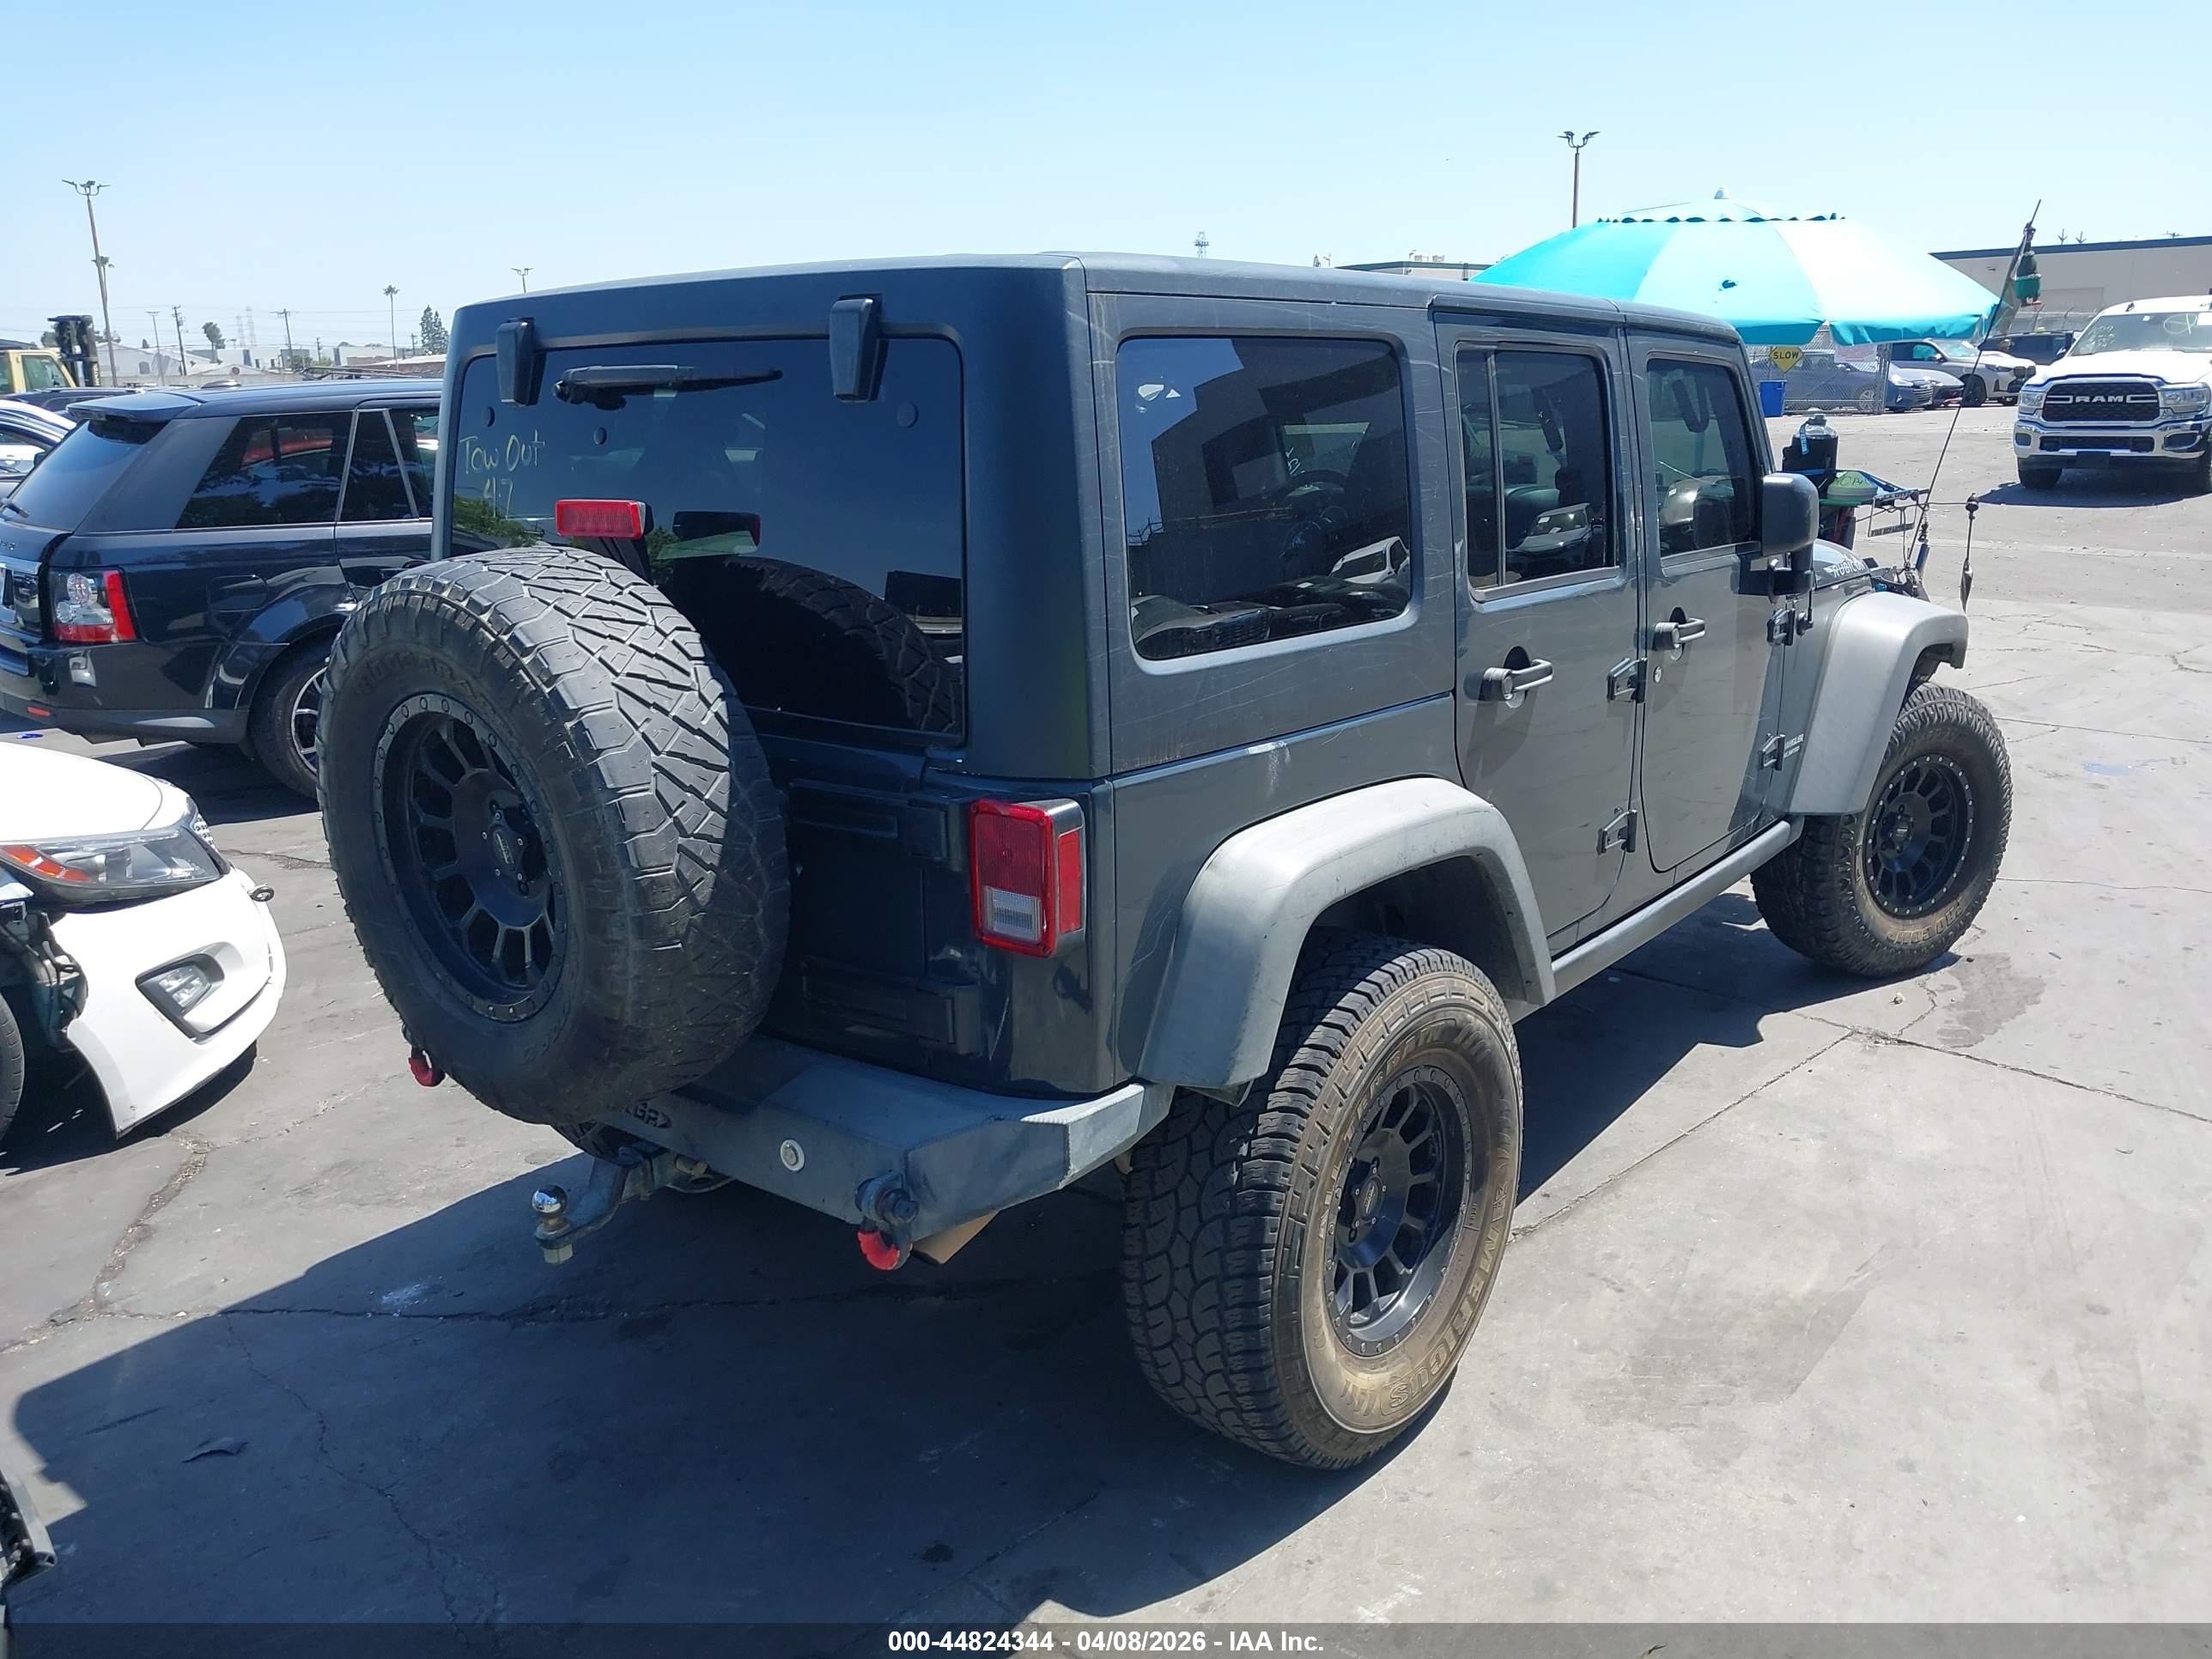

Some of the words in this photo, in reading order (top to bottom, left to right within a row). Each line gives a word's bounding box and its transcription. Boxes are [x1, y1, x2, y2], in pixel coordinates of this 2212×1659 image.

[1772, 350, 1800, 360] SLOW
[2075, 394, 2124, 404] RAM
[505, 428, 546, 472] Out
[1832, 560, 1865, 579] RUBICON
[1386, 1181, 1509, 1410] AMERICUS
